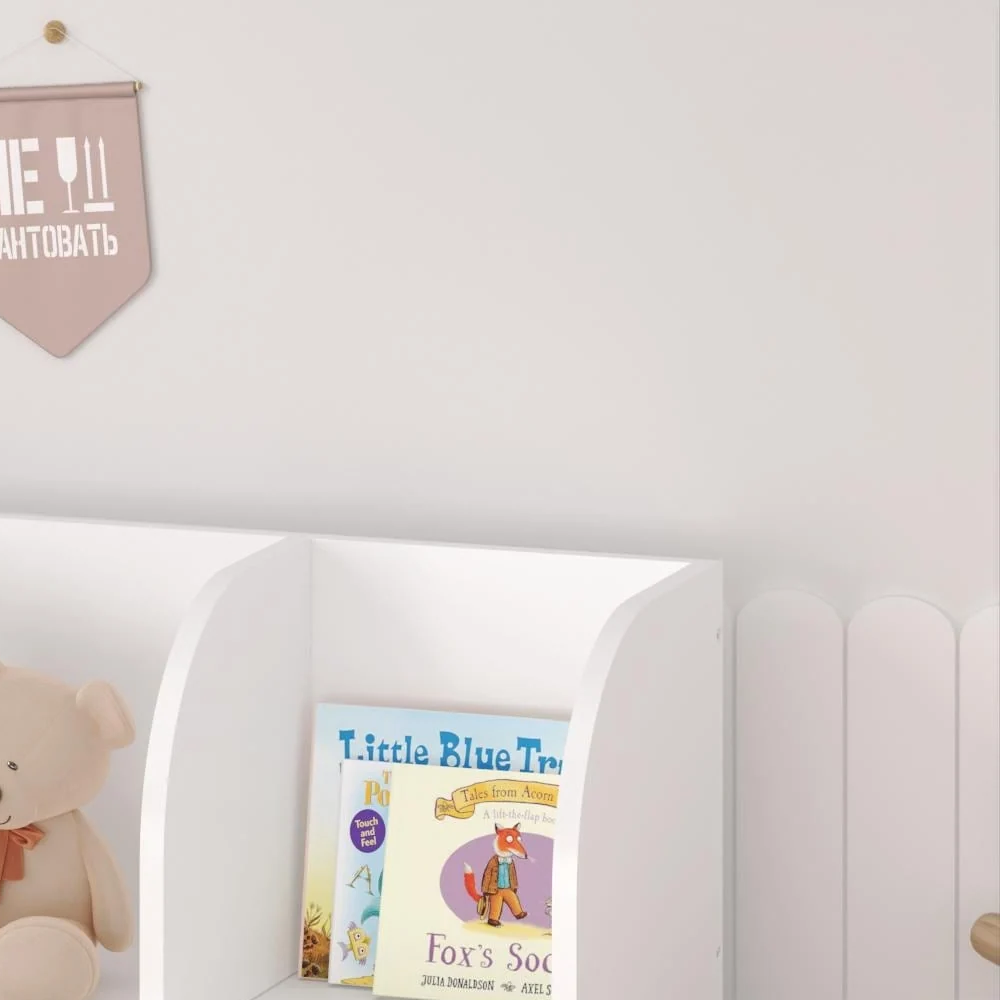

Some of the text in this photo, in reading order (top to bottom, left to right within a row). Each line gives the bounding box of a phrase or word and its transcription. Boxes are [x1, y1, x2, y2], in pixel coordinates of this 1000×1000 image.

[339, 729, 429, 765] Little
[439, 731, 511, 772] Blue
[460, 785, 554, 802] Tales from Acorn
[355, 817, 379, 829] Touch
[360, 827, 376, 838] and
[361, 836, 377, 847] Feel
[425, 932, 493, 968] Fox's
[421, 974, 445, 987] JULIA
[447, 976, 496, 991] DONALDSON
[521, 982, 545, 995] AXEL
